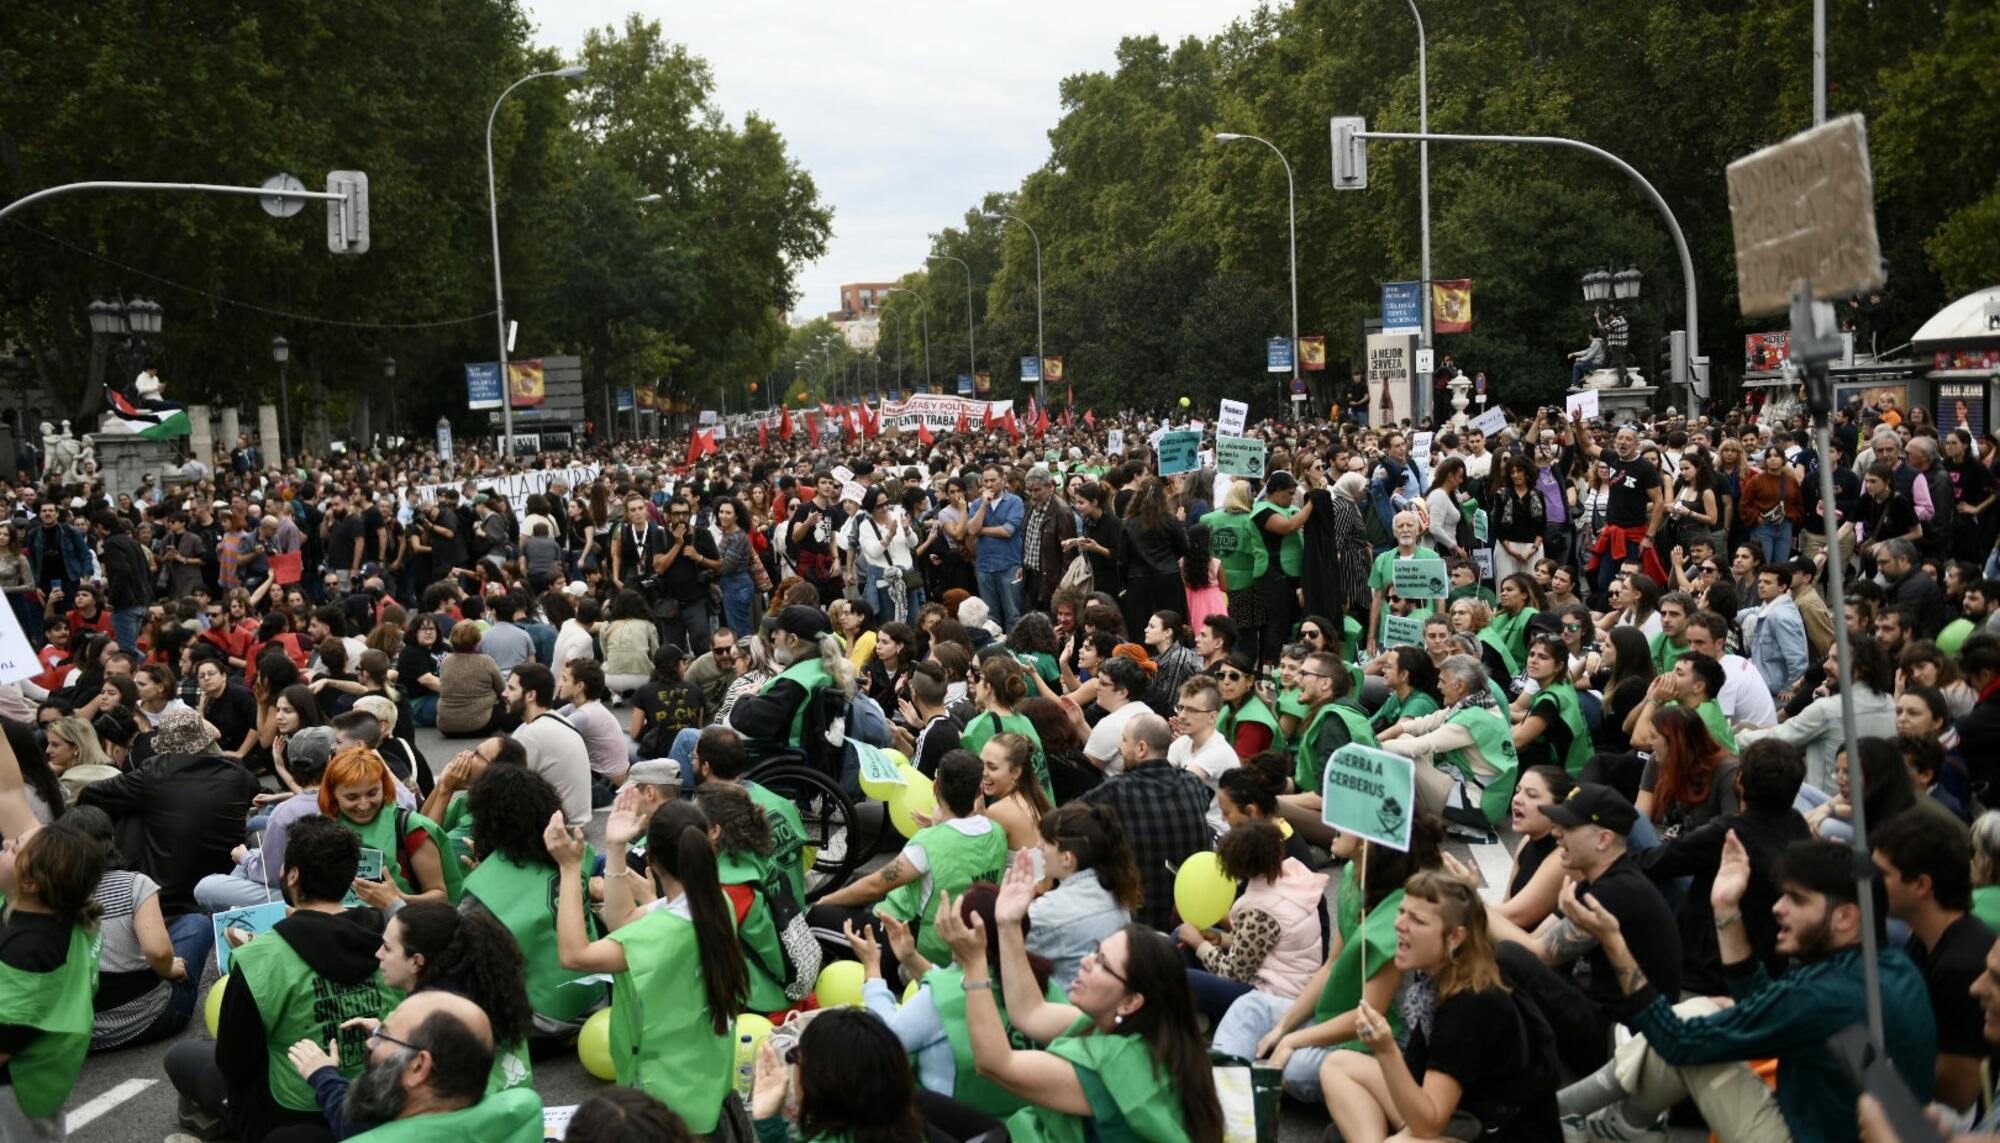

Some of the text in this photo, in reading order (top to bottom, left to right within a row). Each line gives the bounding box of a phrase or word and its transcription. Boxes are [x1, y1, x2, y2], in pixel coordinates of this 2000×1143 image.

[1371, 348, 1403, 360] LA MEJOR
[1372, 358, 1402, 369] CERVEZA
[1369, 368, 1407, 380] DEL MUNDO
[1213, 535, 1236, 545] STOP
[1375, 762, 1383, 777] A
[1329, 770, 1385, 798] CERBERUS
[314, 988, 382, 1023] SIN GENTE
